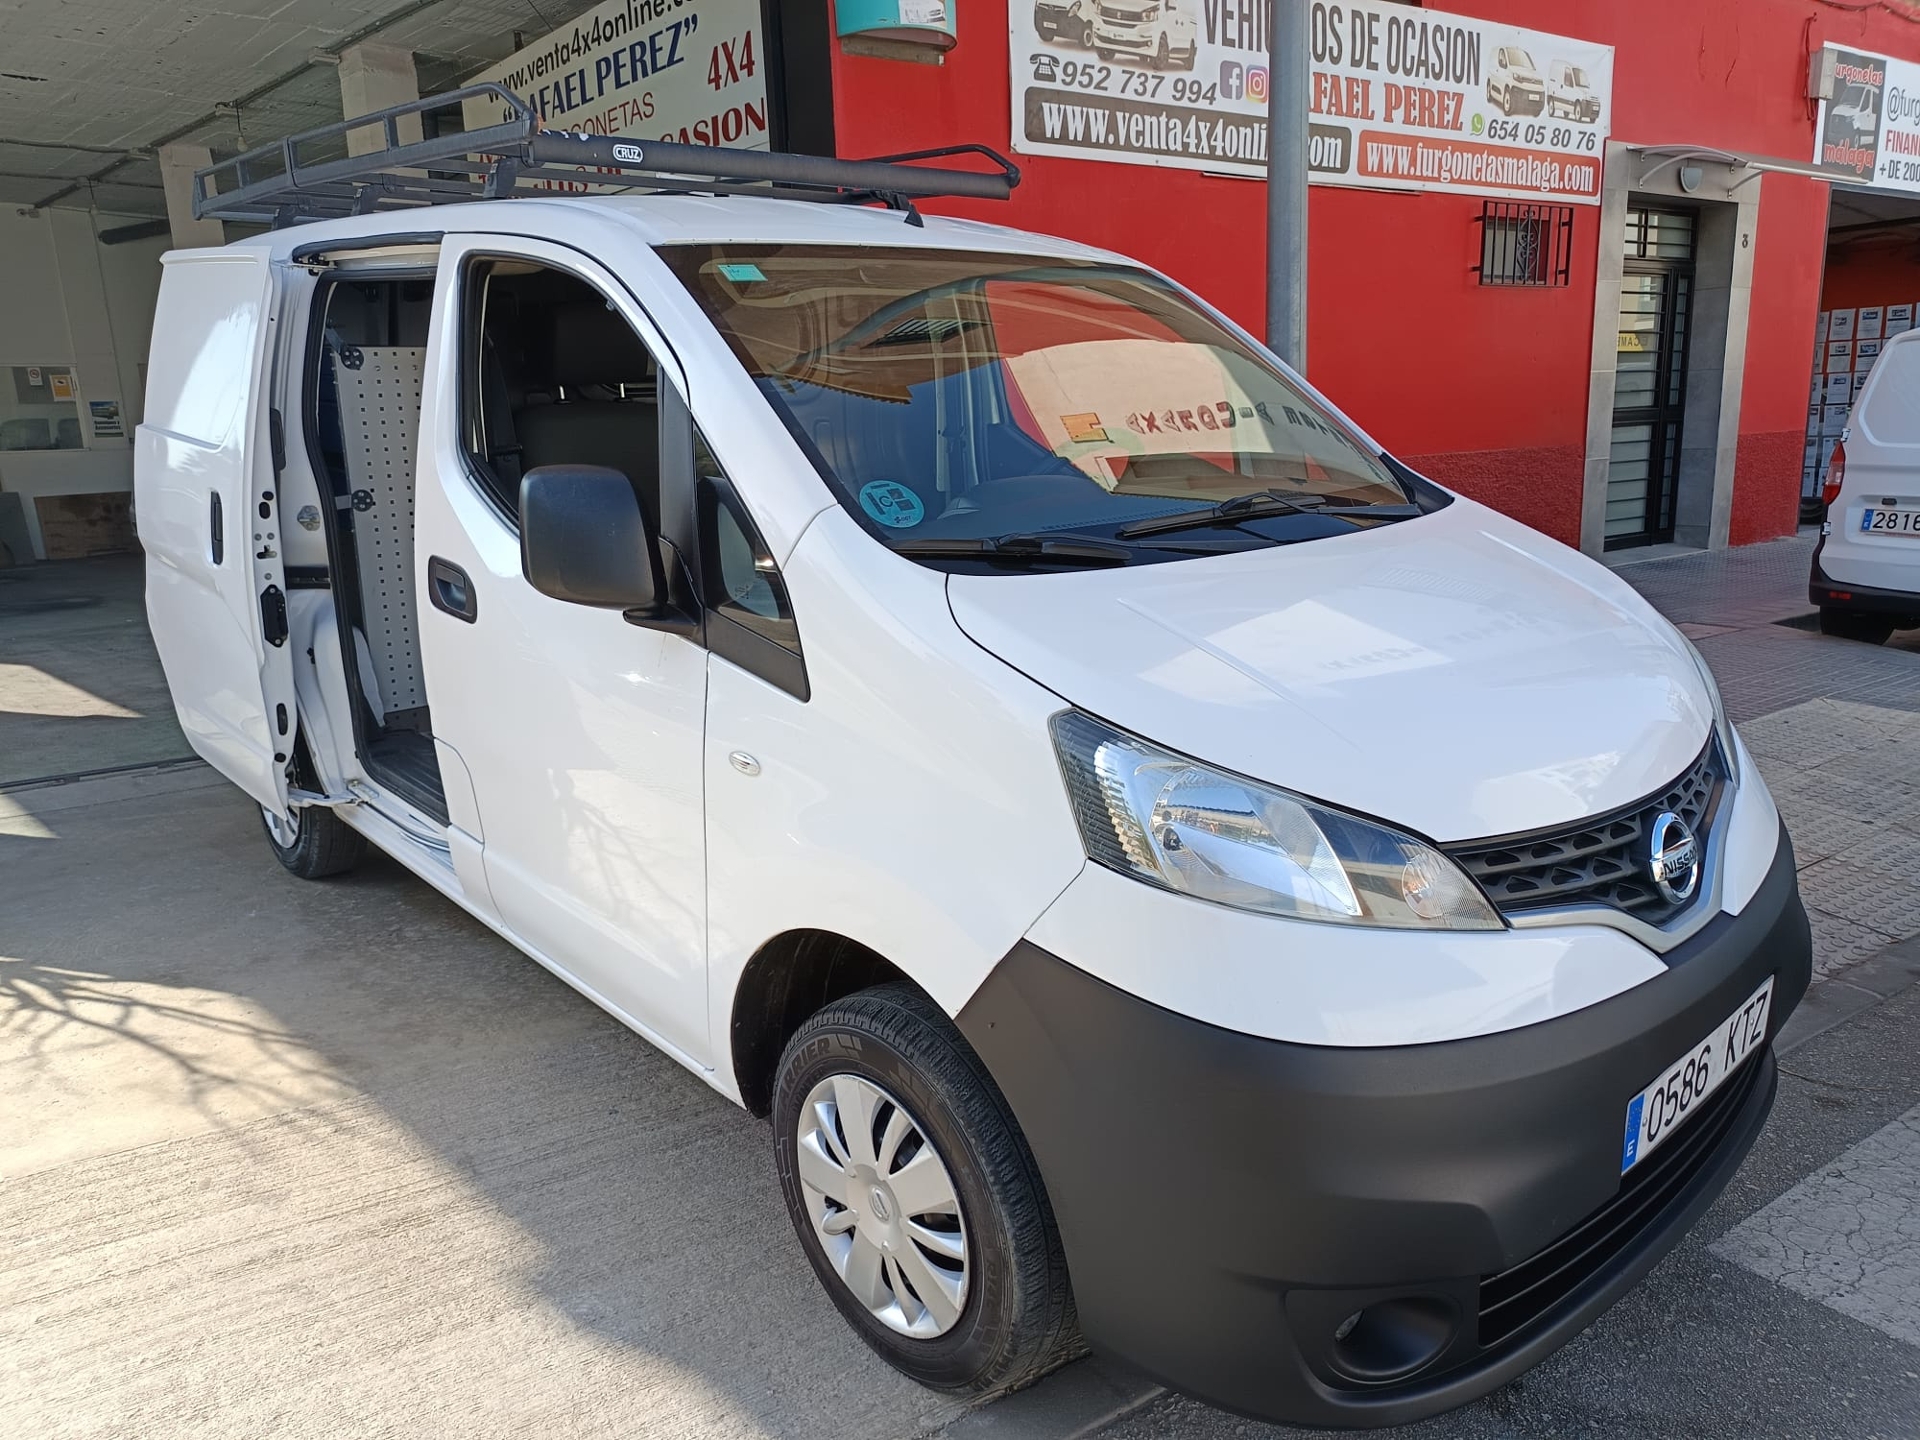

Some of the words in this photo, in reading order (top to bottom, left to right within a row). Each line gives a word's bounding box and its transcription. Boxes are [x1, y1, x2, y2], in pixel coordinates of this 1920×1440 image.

[488, 0, 693, 104] www.venta4x4online.
[707, 30, 756, 91] 4X4
[1204, 0, 1342, 65] VEHIOS
[1350, 9, 1380, 71] DE
[1386, 16, 1480, 86] OCASION
[1061, 60, 1111, 92] 952
[1119, 68, 1165, 99] 737
[1171, 77, 1217, 105] 994
[1835, 62, 1884, 86] urgonetas
[1308, 72, 1375, 121] FAEL
[1383, 82, 1464, 132] PEREZ
[615, 147, 640, 160] CRUZ
[1487, 119, 1519, 142] 654
[1524, 124, 1546, 145] 05
[1550, 127, 1571, 149] 80
[1577, 131, 1596, 151] 76
[1885, 129, 1920, 156] FINAN
[1366, 141, 1594, 193] www.furgonetasmalaga.com
[1888, 159, 1901, 179] DE
[1664, 845, 1697, 876] NISSAN
[1647, 1044, 1713, 1143] 0586
[1724, 992, 1768, 1072] KTZ
